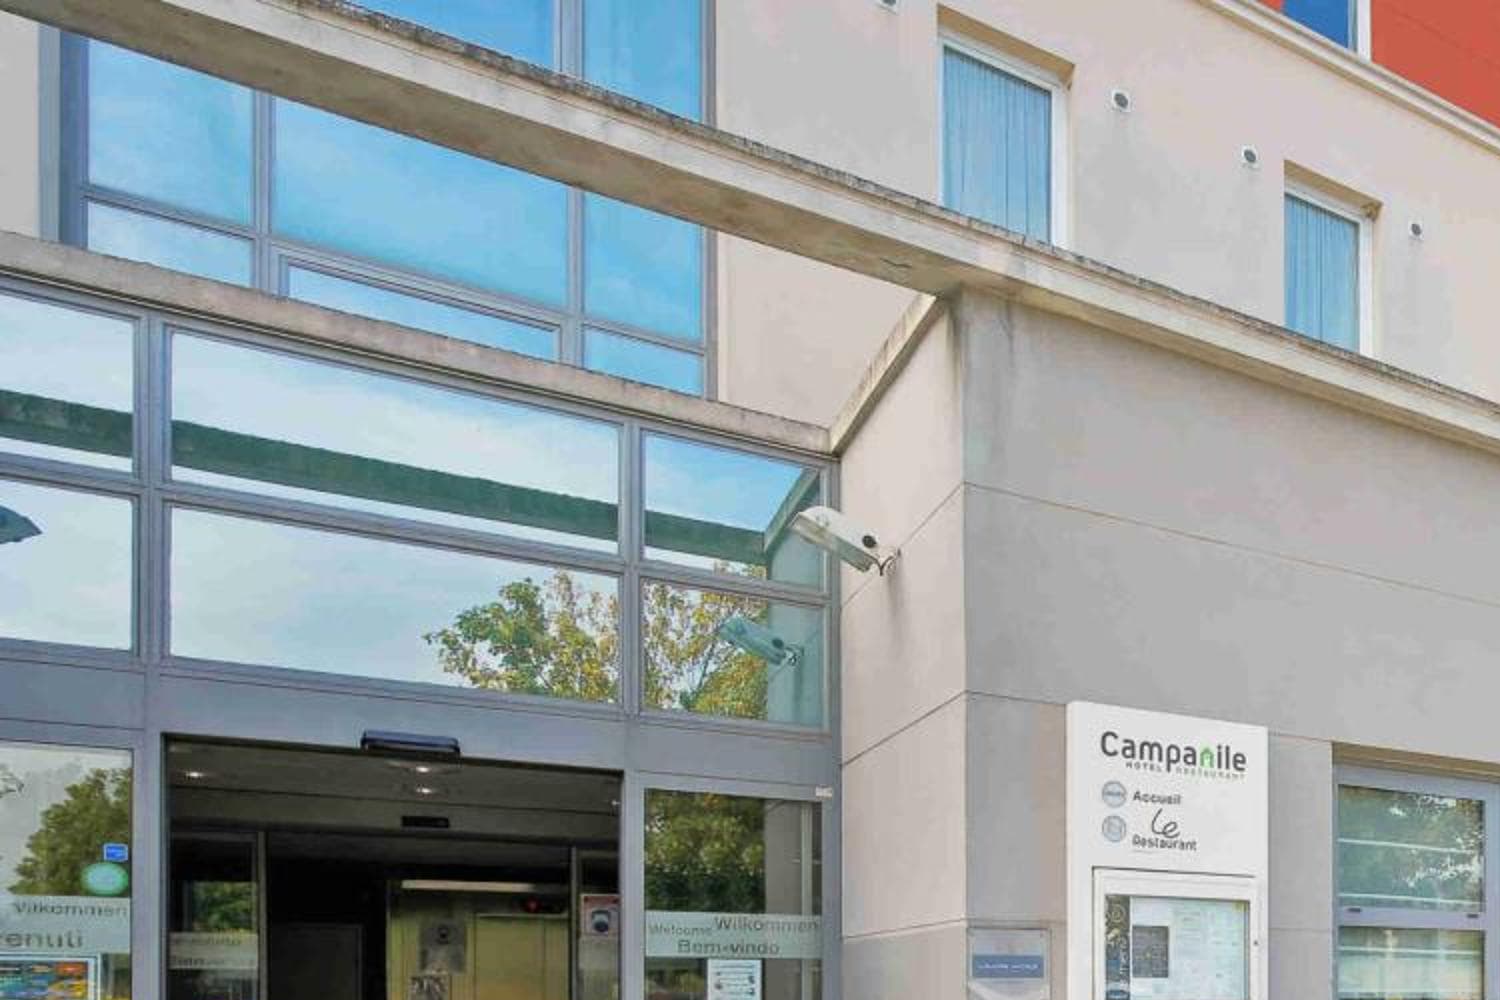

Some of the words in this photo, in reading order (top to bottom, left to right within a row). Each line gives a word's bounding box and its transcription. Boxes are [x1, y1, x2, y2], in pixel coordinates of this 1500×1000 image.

[1100, 731, 1247, 773] Campanile
[1133, 790, 1182, 805] Accueil
[1132, 833, 1198, 851] Restaurant
[0, 929, 84, 949] enuti
